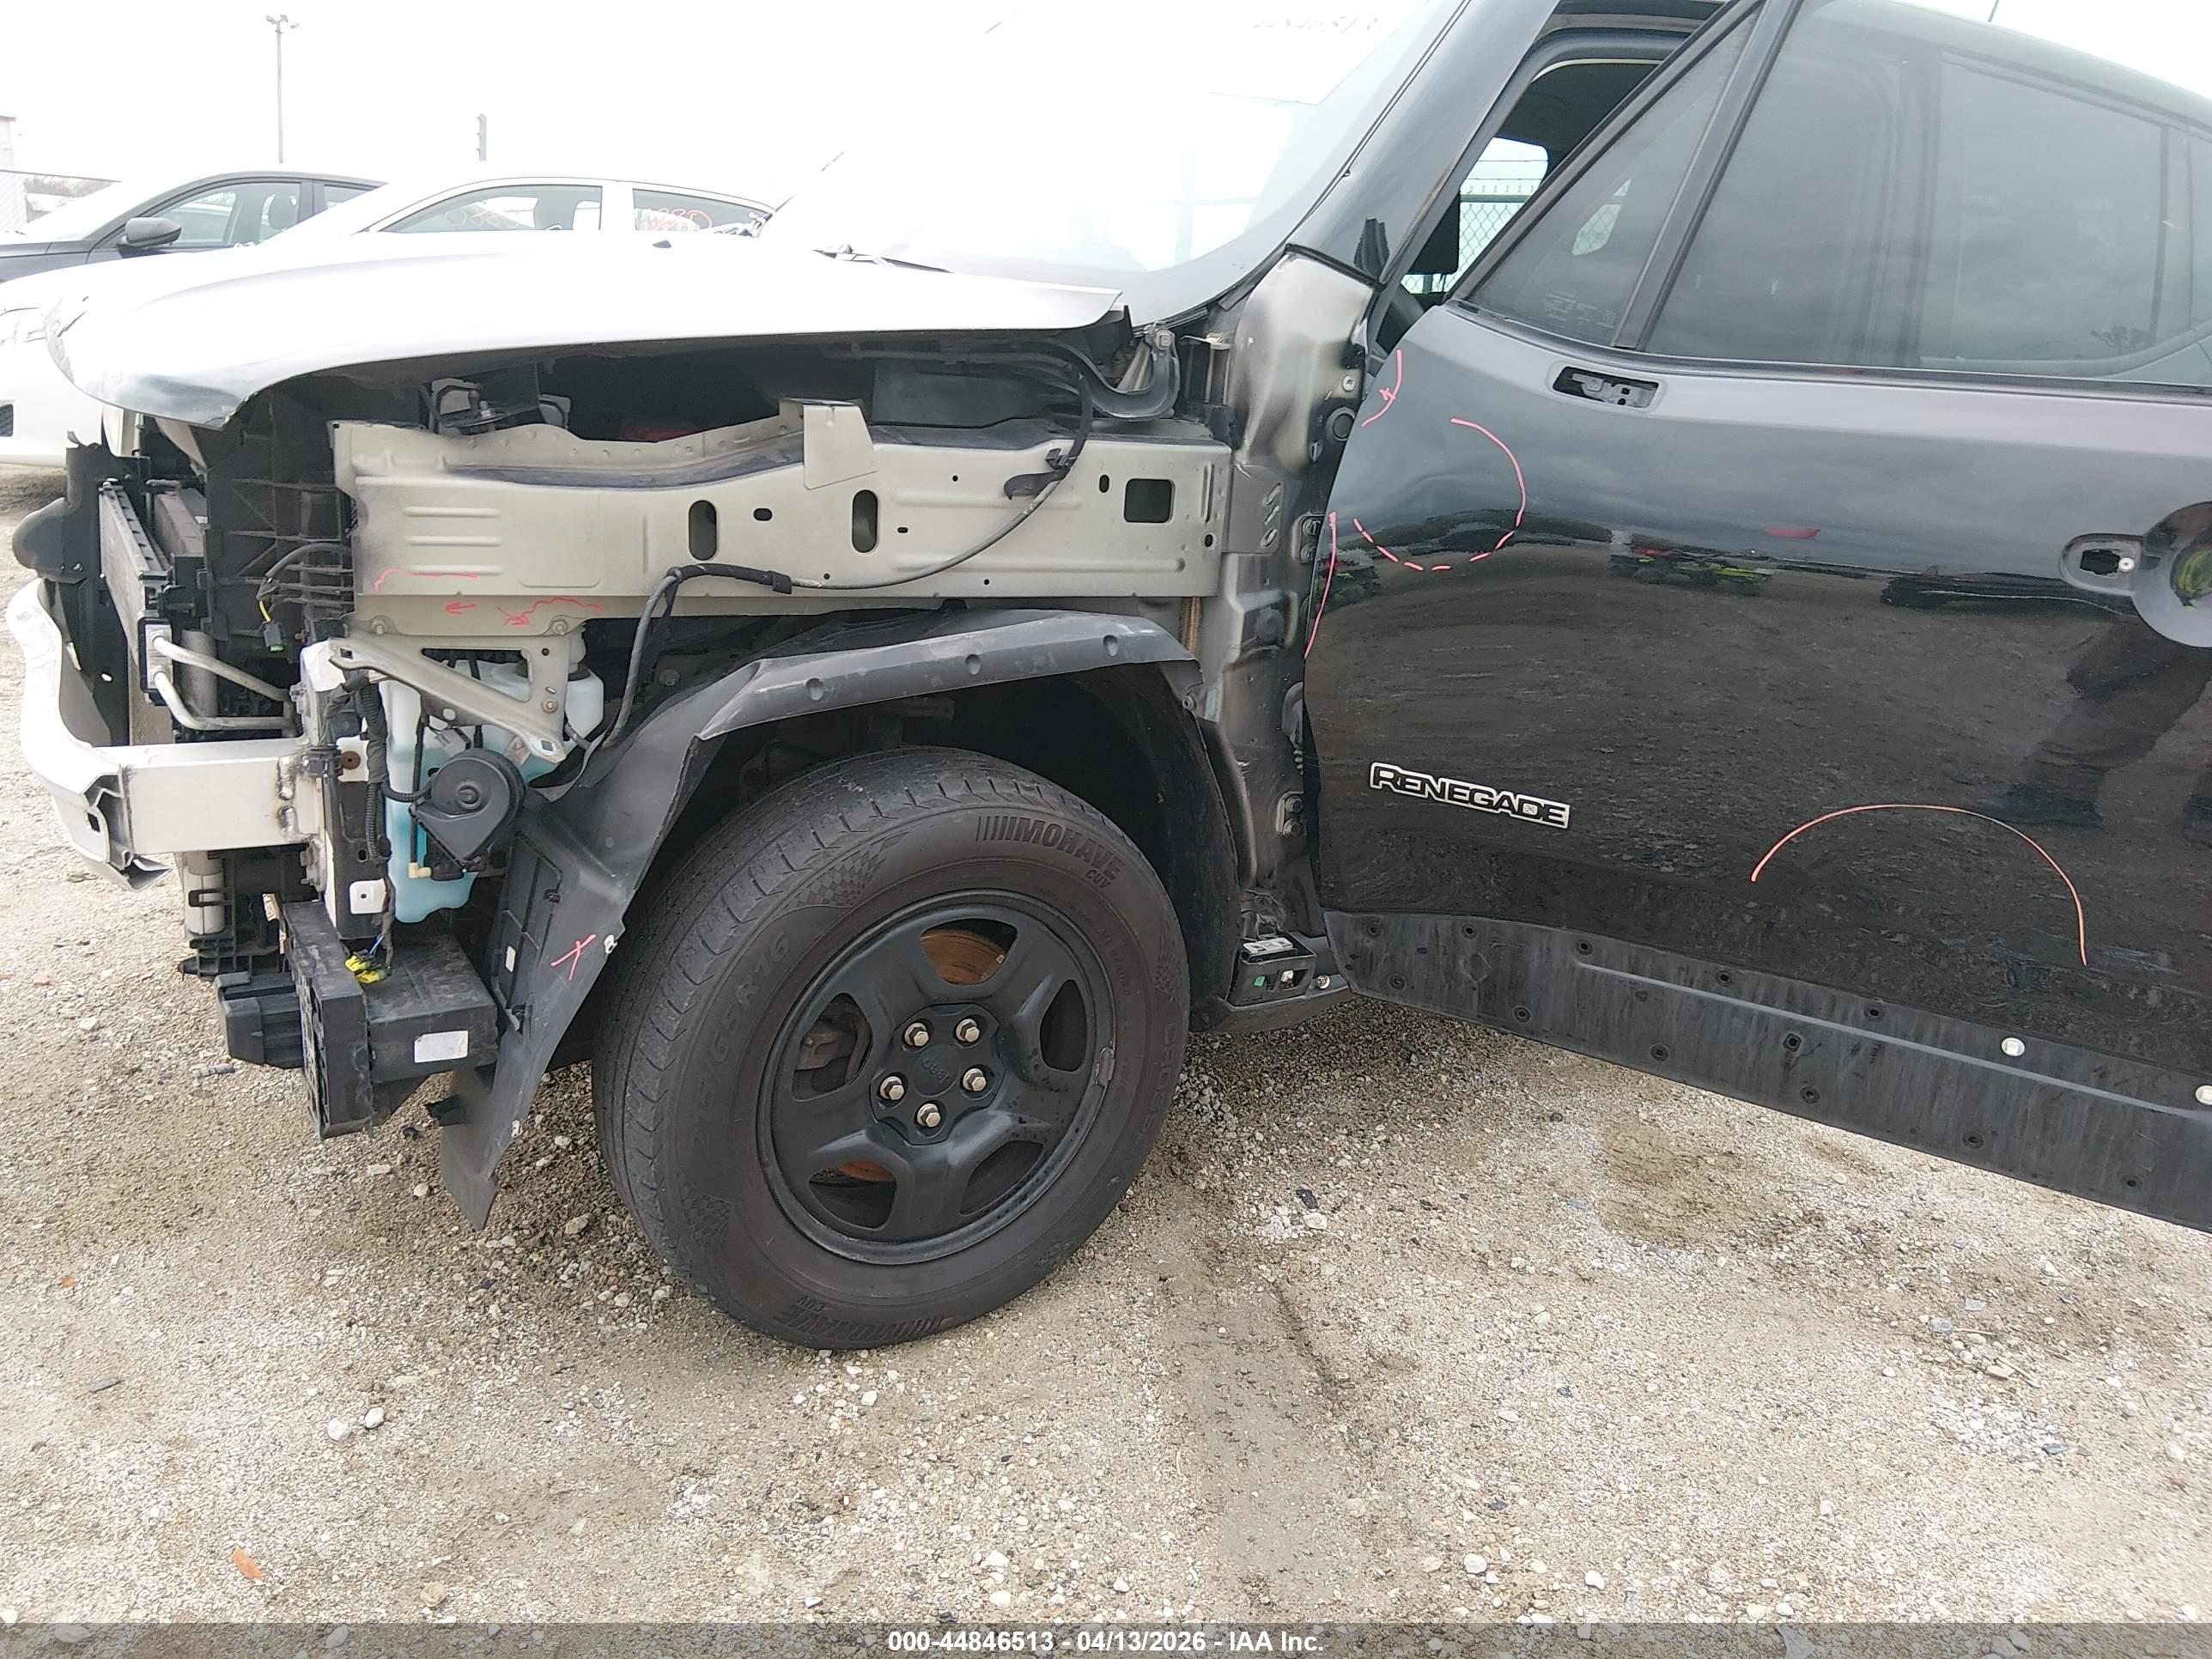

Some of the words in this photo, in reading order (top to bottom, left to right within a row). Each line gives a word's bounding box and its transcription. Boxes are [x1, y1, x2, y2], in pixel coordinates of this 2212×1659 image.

[1370, 762, 1571, 830] RENEGADE
[1013, 816, 1125, 881] MOHAVE
[1085, 869, 1111, 888] CUV
